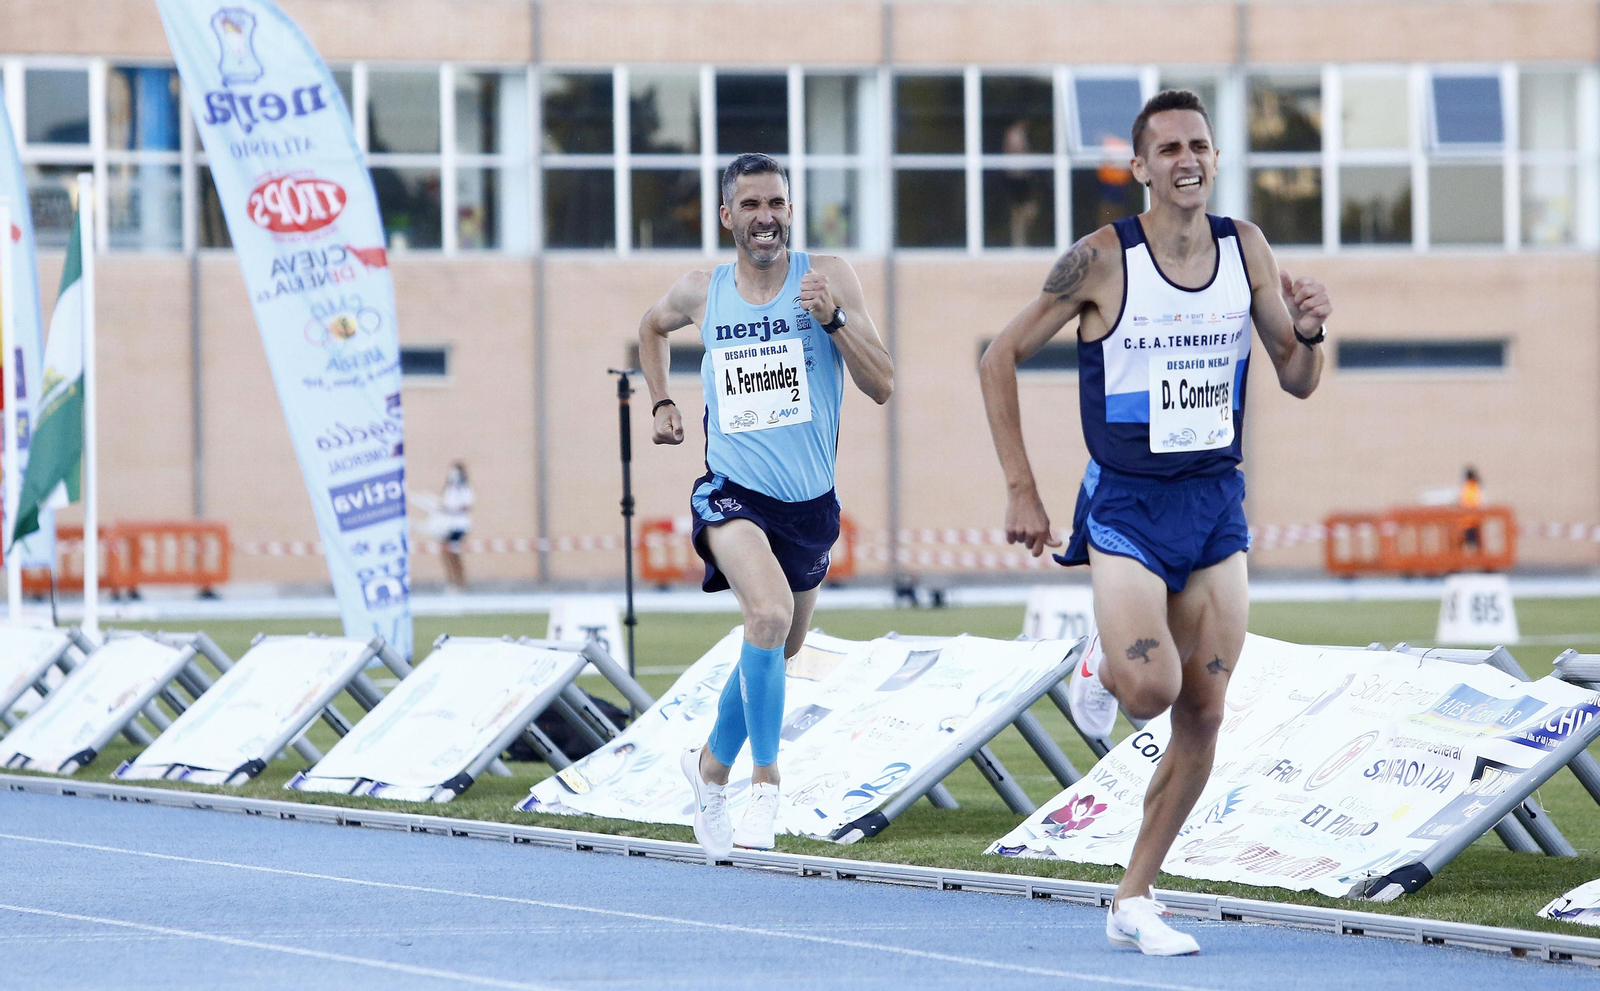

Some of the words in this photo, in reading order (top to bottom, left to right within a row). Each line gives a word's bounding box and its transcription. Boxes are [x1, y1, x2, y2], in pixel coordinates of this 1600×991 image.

[716, 316, 790, 342] nerja
[725, 347, 757, 361] DESAFÍO
[760, 344, 788, 356] NERJA
[1167, 358, 1205, 370] DESAFÍO
[725, 369, 736, 396] A.
[736, 362, 799, 394] Fernández
[791, 388, 800, 402] 2
[1162, 379, 1175, 410] D.
[1299, 804, 1333, 828] El
